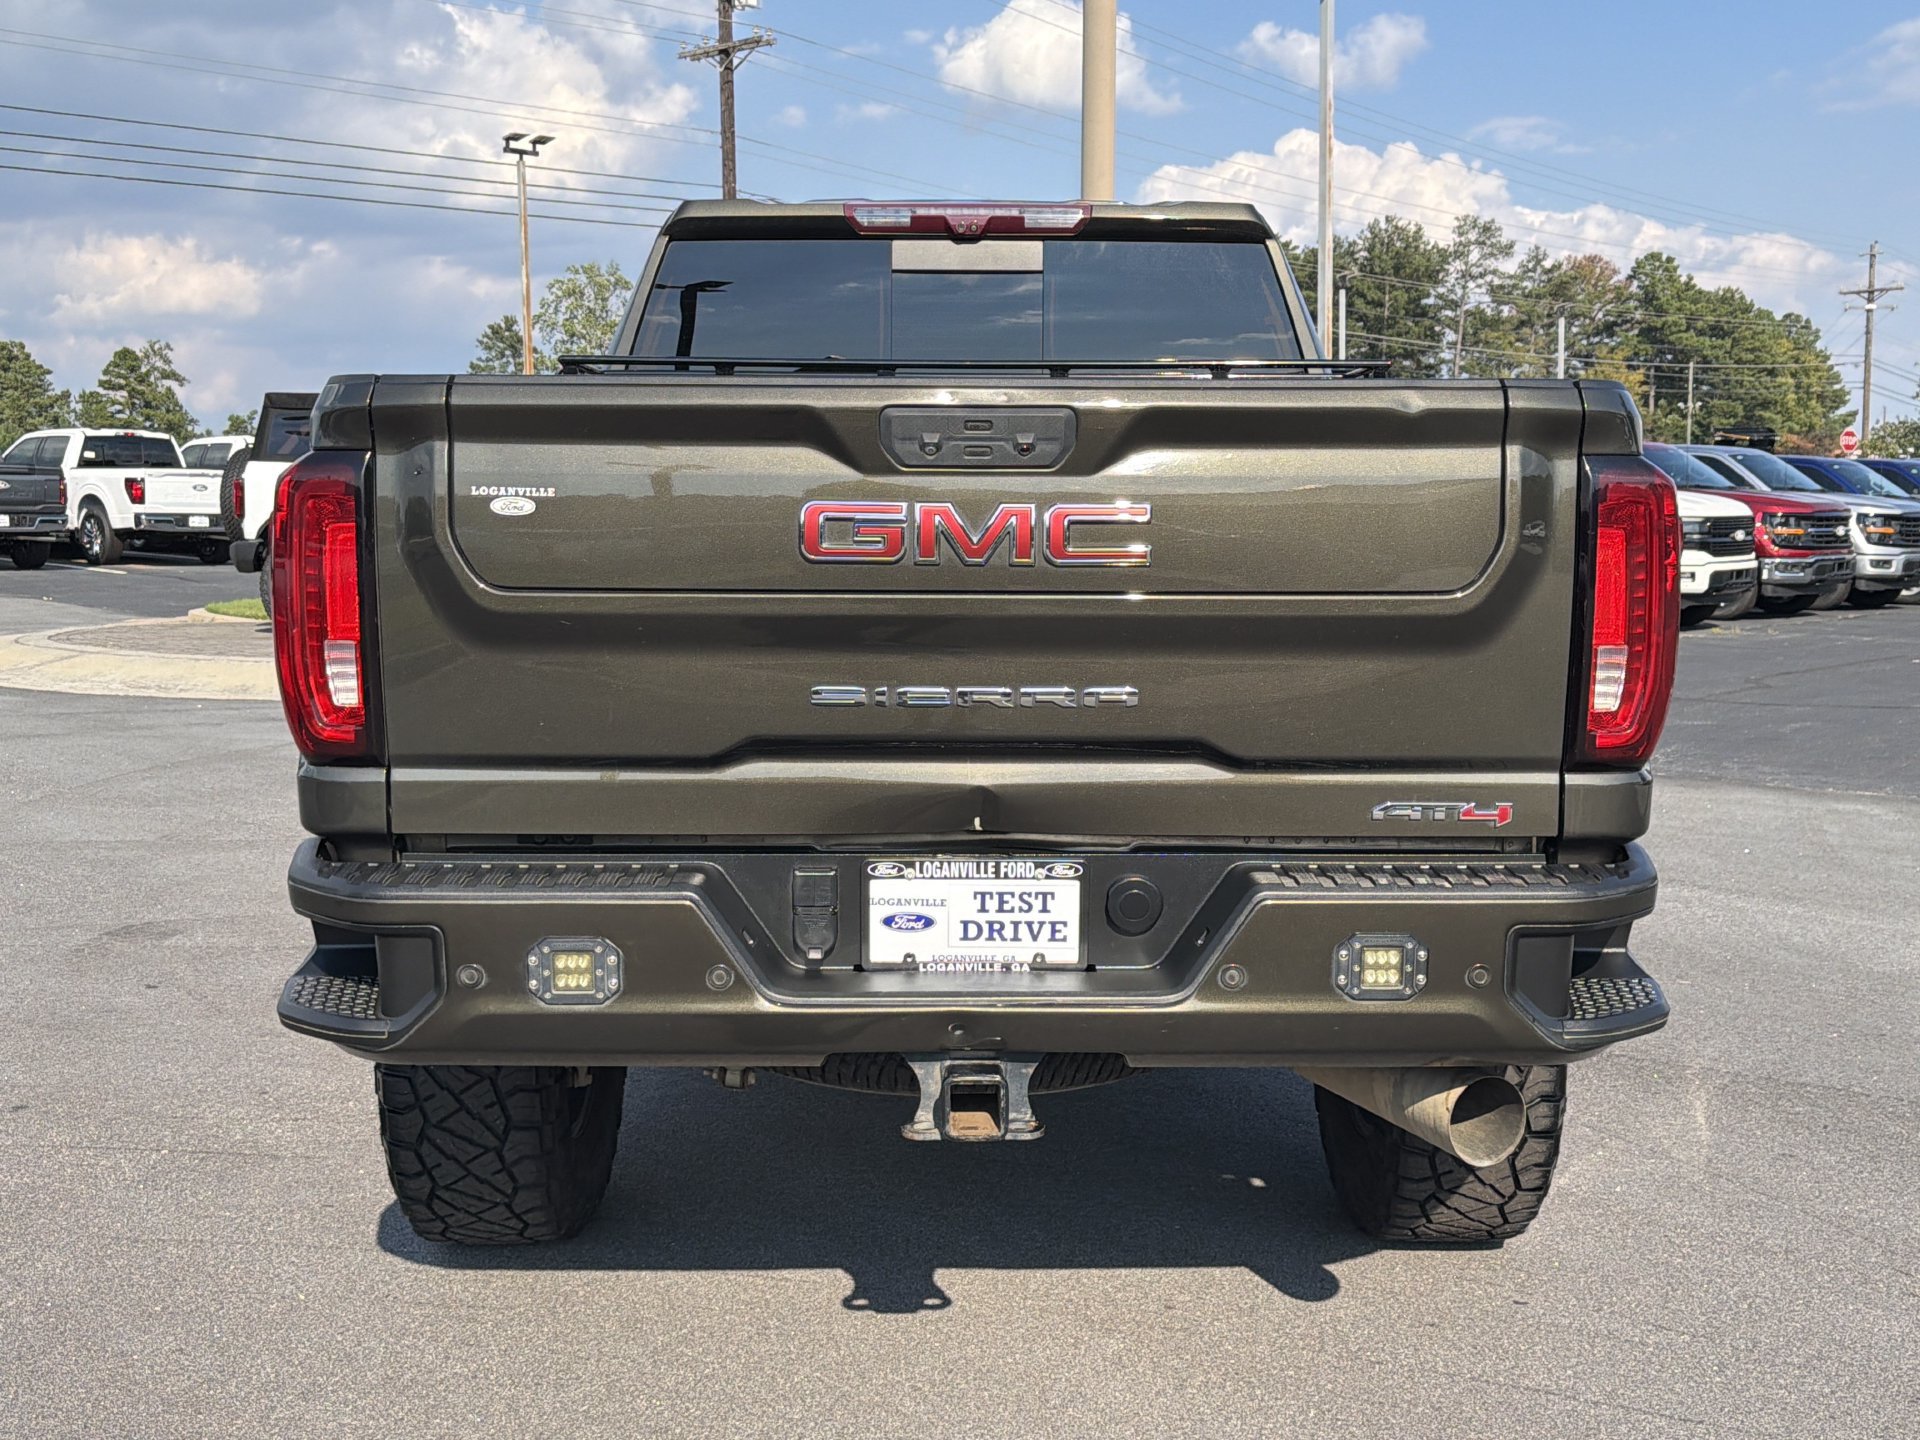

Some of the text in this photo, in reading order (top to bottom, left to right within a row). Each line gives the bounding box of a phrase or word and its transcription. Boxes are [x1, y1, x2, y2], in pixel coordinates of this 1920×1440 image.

[1841, 435, 1857, 445] STOP
[471, 486, 555, 497] LOGANVILLE
[500, 501, 525, 511] Ford
[800, 501, 1151, 566] GMC
[810, 686, 1139, 707] SIERRA
[1371, 801, 1513, 828] AT4
[875, 864, 898, 875] Ford
[915, 861, 1035, 879] LOGANVILLE FORD
[1051, 864, 1075, 875] Ford
[868, 897, 947, 907] LOGANVILLE
[973, 891, 1056, 914] TEST
[891, 914, 925, 929] Ford
[959, 920, 1068, 943] DRIVE
[1011, 962, 1030, 972] GA
